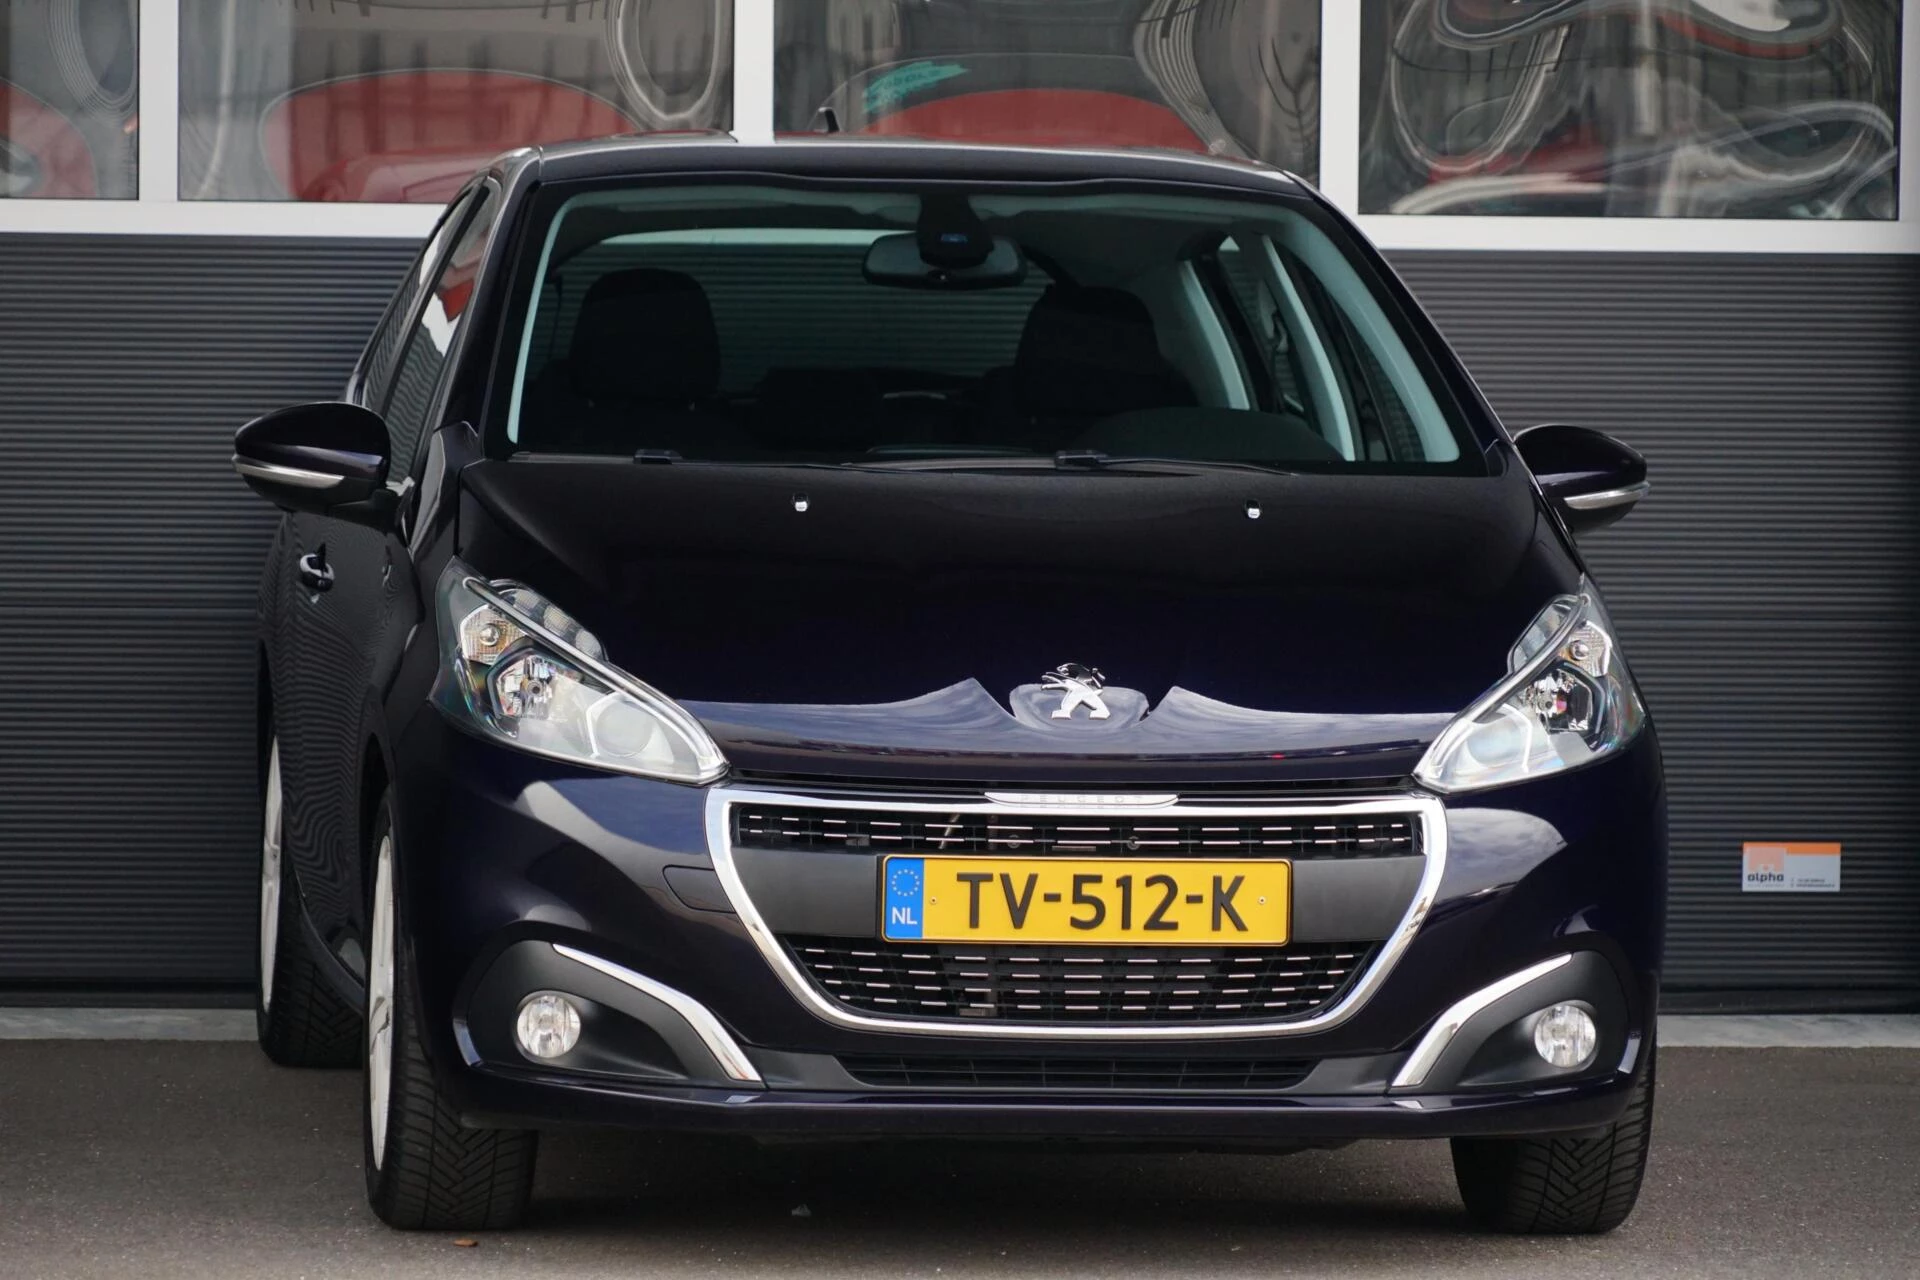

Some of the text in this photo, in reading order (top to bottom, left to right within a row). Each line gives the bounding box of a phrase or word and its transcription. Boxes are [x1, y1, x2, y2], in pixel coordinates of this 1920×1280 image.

[1019, 794, 1143, 803] PEUGEOT
[1747, 872, 1785, 883] alpha
[956, 872, 1249, 932] TV-512-K
[891, 906, 918, 925] NL
